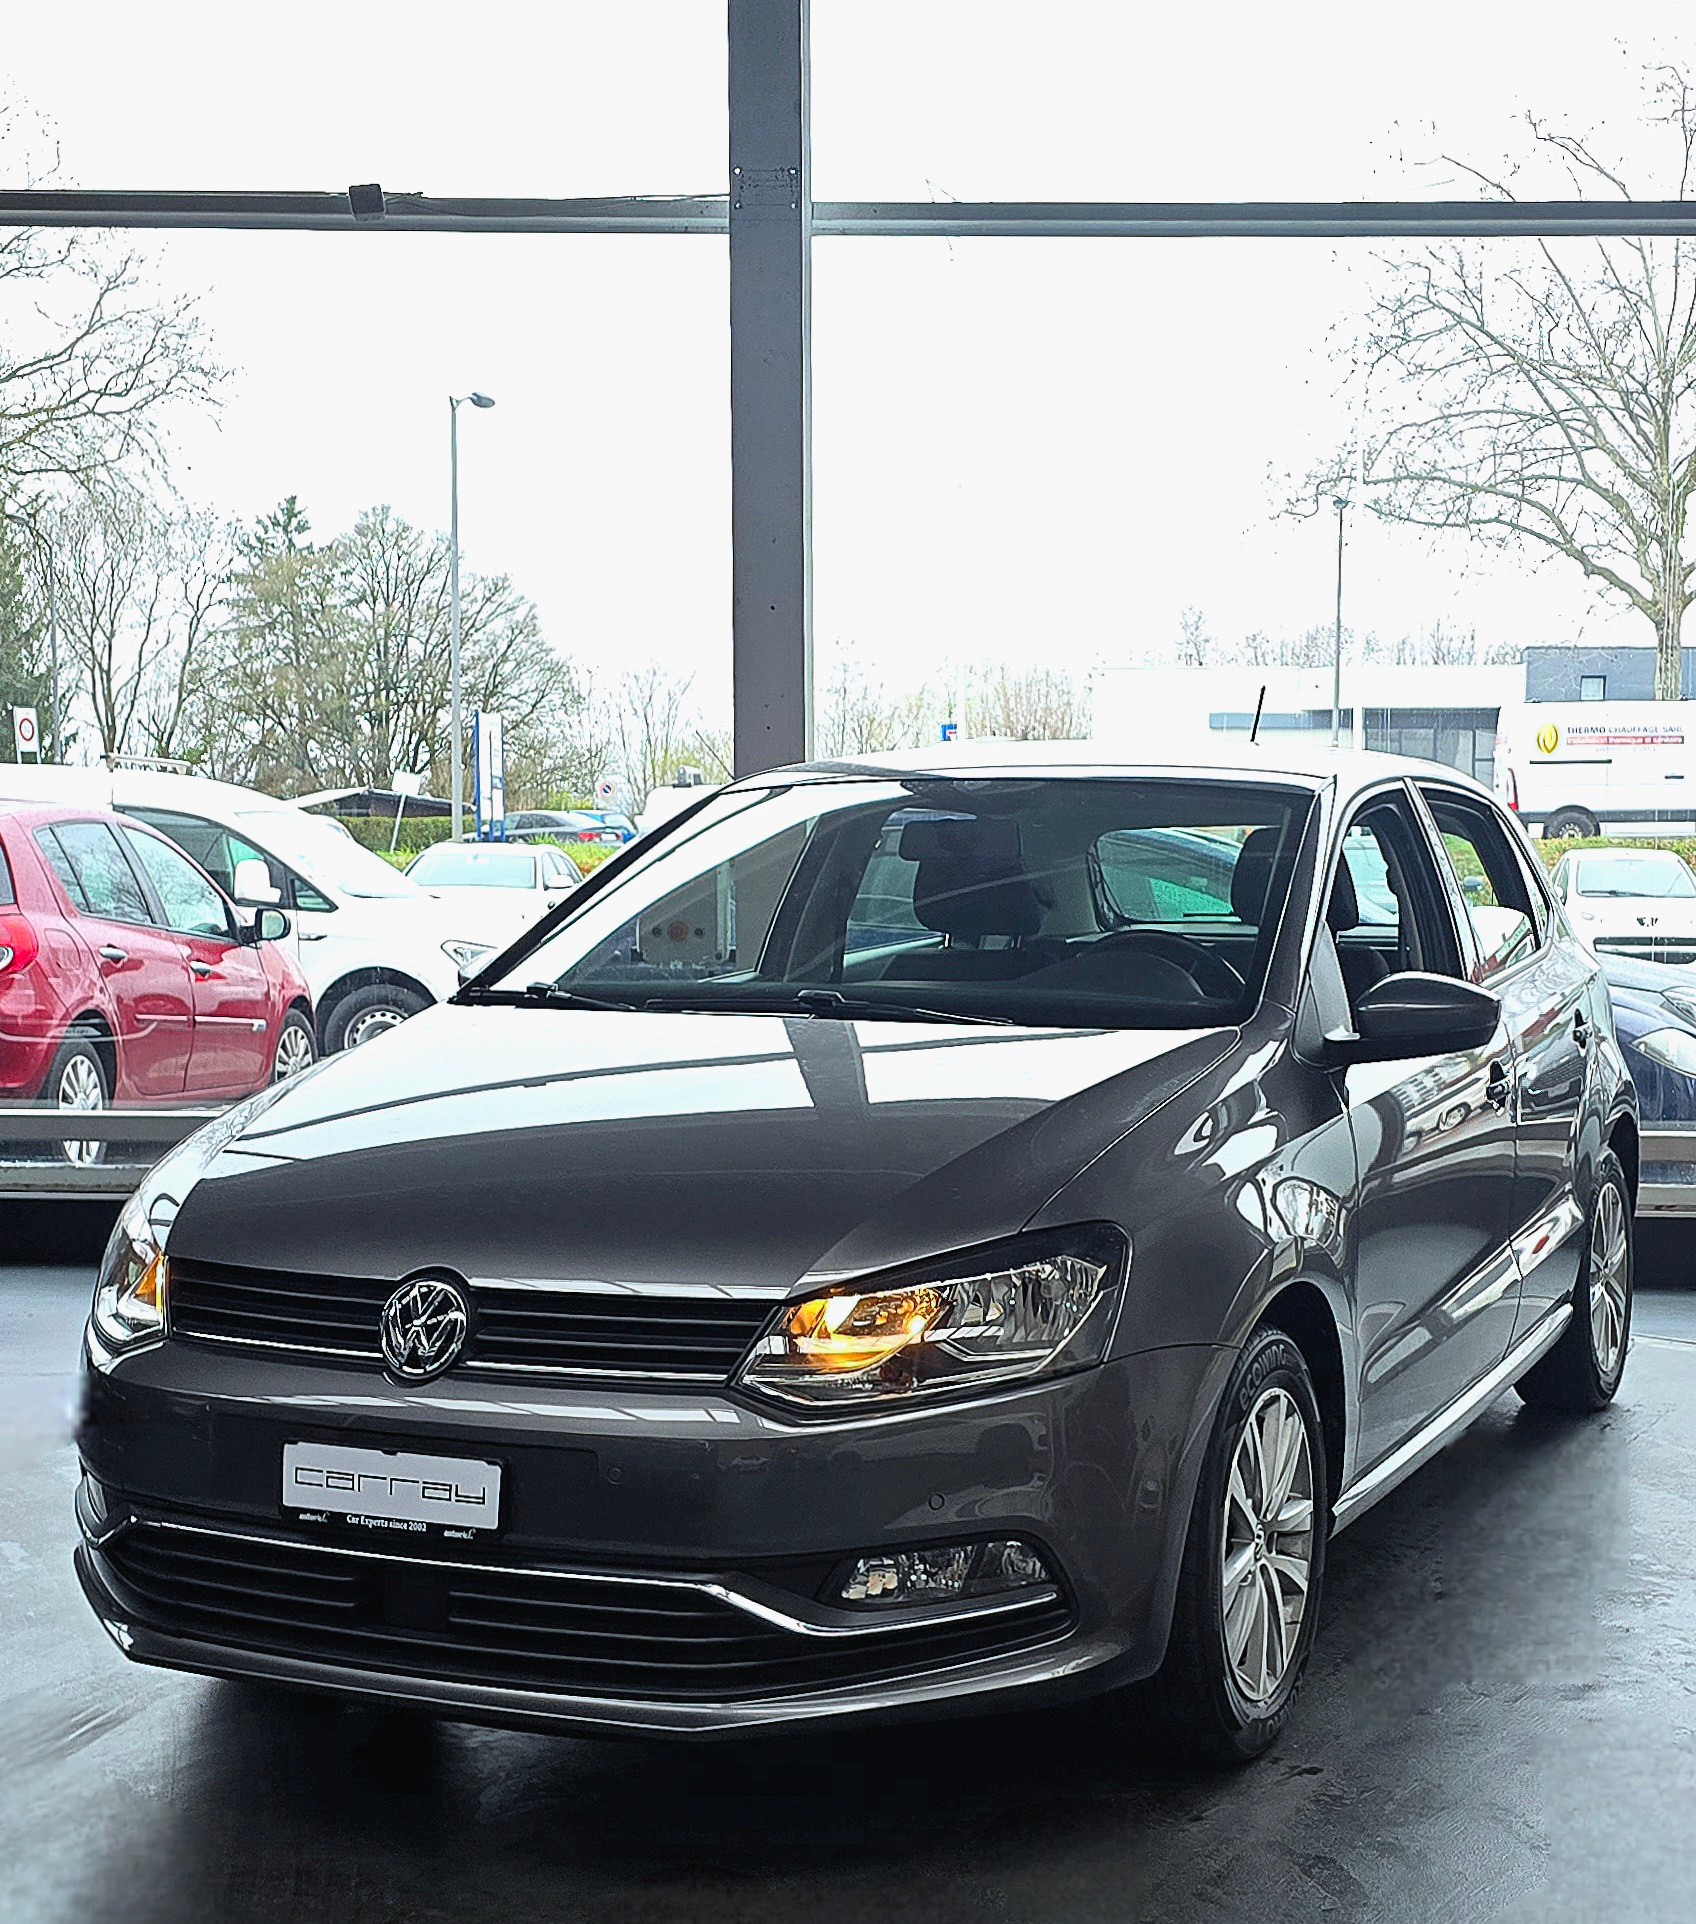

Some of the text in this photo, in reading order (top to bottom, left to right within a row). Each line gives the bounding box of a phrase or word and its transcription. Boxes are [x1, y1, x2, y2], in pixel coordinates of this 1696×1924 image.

[1567, 725, 1683, 734] THERMO CHAUFFAGE SARL
[294, 1466, 486, 1506] carray
[346, 1514, 427, 1532] Car Experts since 2002
